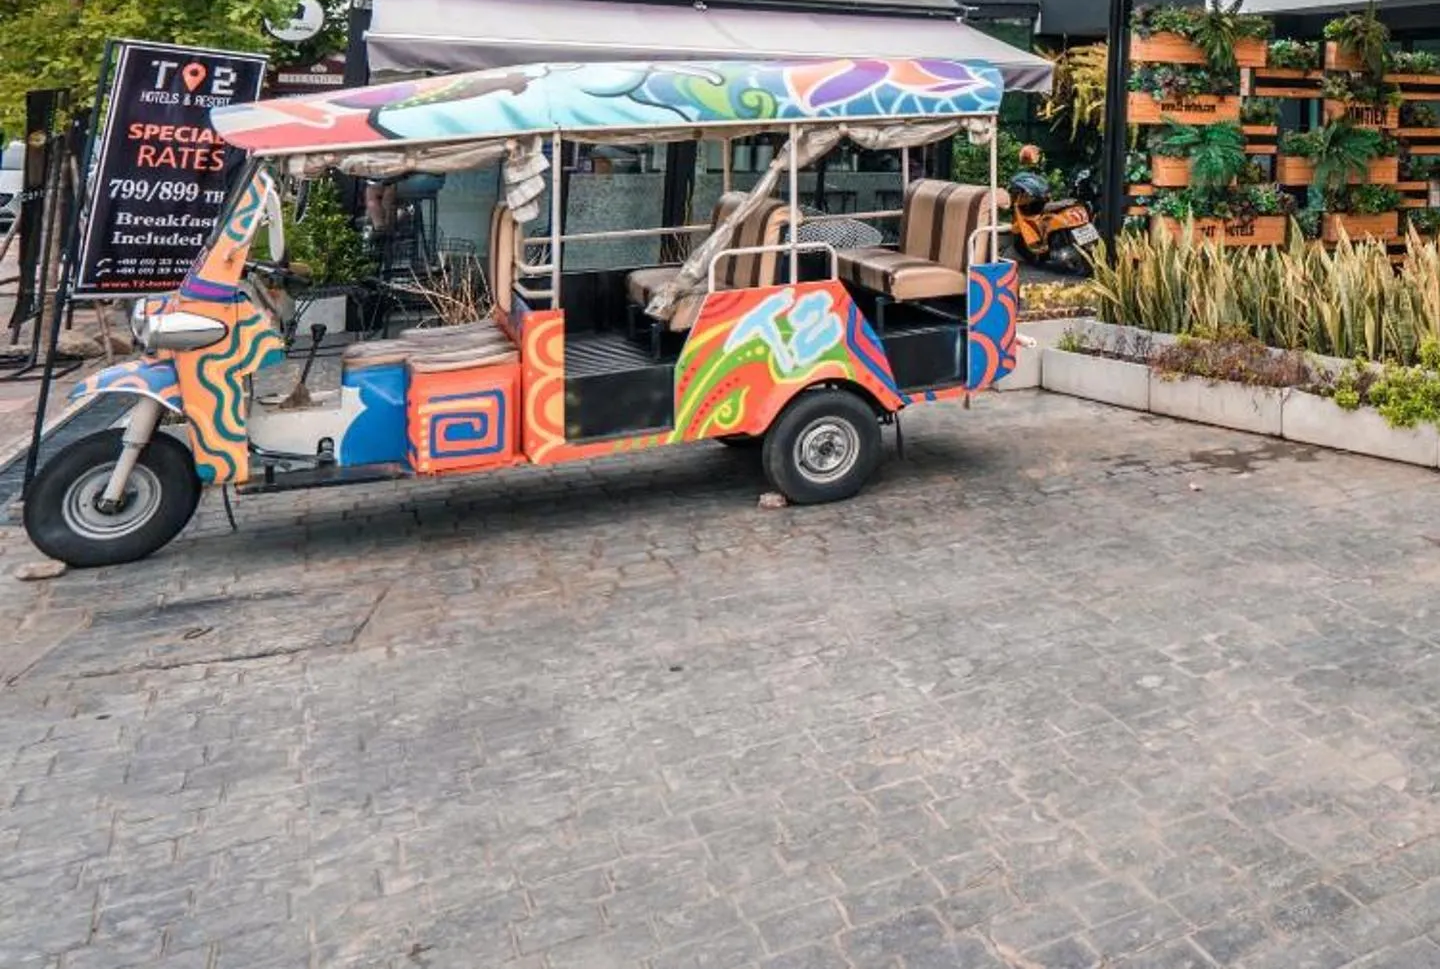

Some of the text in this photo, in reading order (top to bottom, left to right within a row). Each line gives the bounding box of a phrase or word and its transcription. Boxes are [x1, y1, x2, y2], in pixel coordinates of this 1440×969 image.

[139, 90, 180, 105] HOTELS
[137, 144, 226, 172] RATES
[108, 178, 200, 203] 799/899
[110, 230, 203, 247] Included
